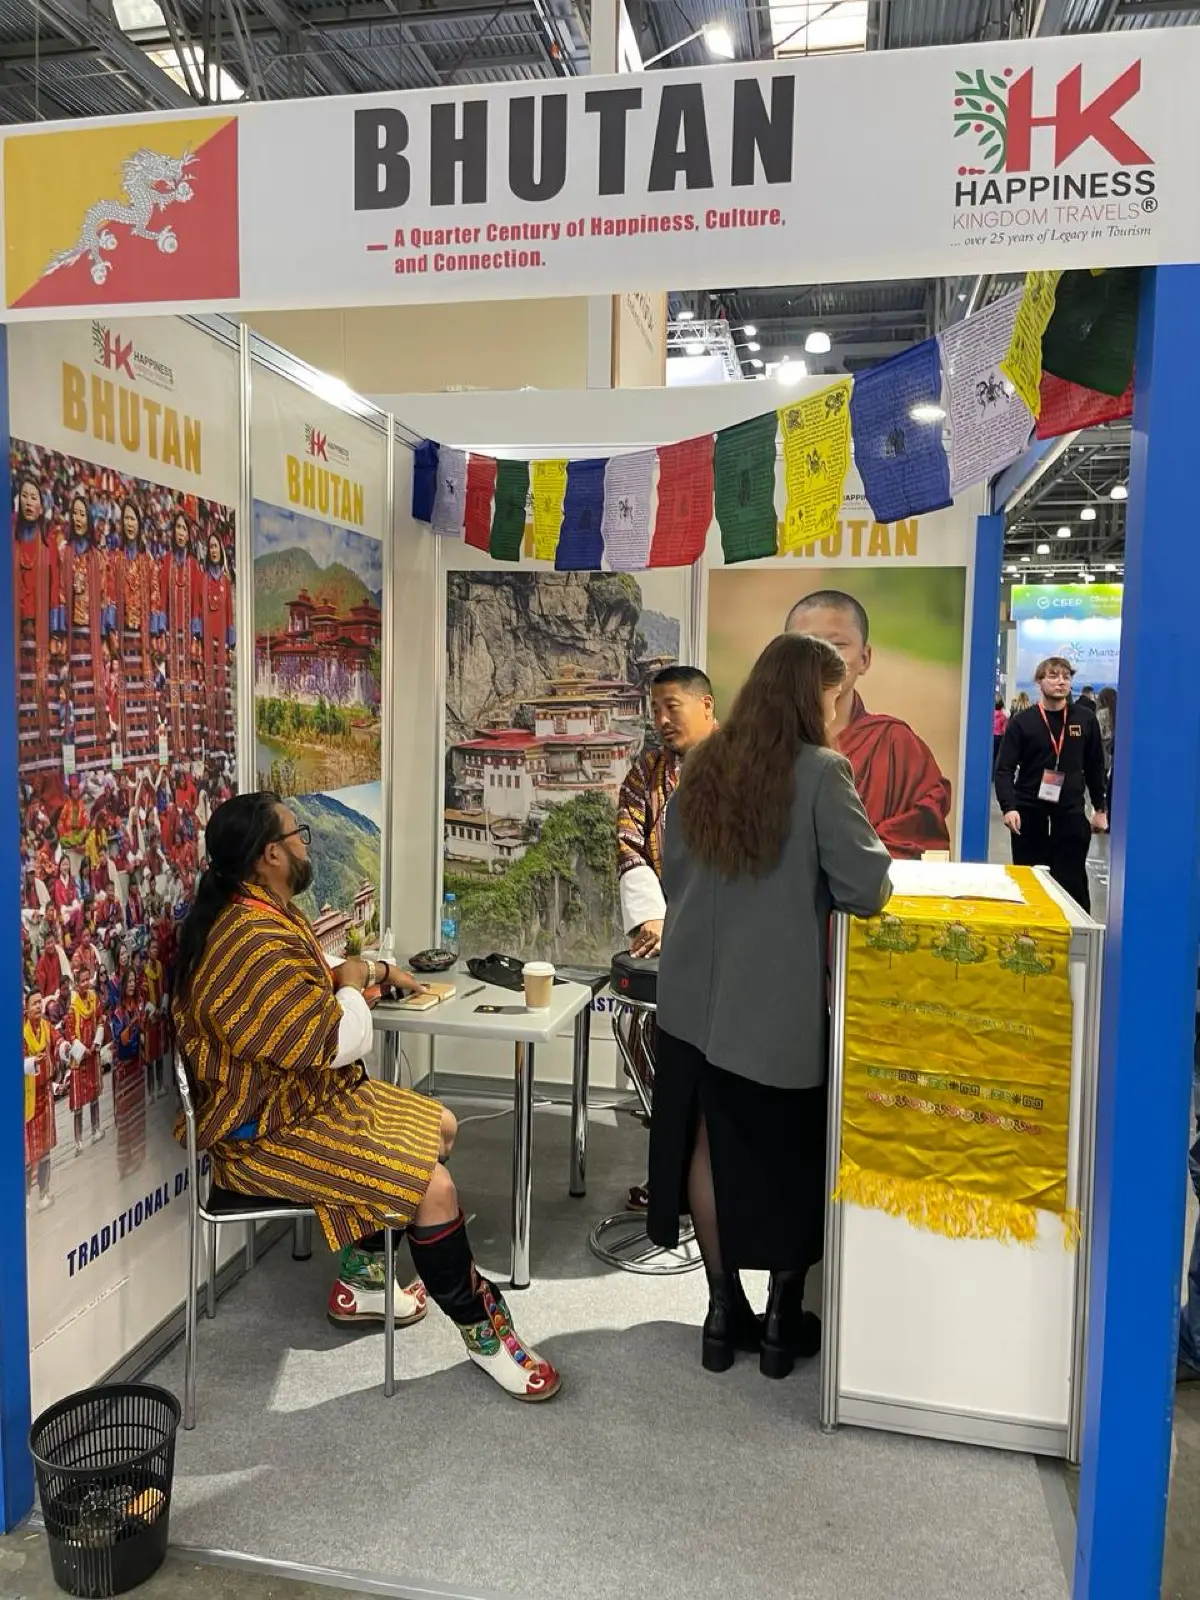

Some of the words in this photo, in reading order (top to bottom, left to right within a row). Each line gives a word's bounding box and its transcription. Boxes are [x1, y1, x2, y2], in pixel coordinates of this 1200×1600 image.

[354, 75, 795, 210] BHUTAN
[1005, 58, 1155, 173] HK
[955, 170, 1155, 207] HAPPINESS
[394, 229, 405, 248] A
[410, 226, 481, 248] Quarter
[486, 221, 561, 242] Century
[566, 218, 585, 238] of
[590, 214, 700, 237] Happiness,
[705, 208, 786, 229] Culture,
[953, 208, 1049, 231] KINGDOM
[964, 235, 987, 247] over
[990, 231, 1005, 246] 25
[1007, 232, 1034, 248] years
[1036, 229, 1051, 247] of
[1050, 228, 1088, 244] Legacy
[1090, 226, 1102, 239] in
[1107, 224, 1152, 238] Tourism
[394, 254, 428, 275] and
[433, 249, 547, 273] Connection.
[62, 360, 202, 475] BHUTAN
[286, 453, 364, 526] BHUTAN
[67, 1182, 170, 1277] TRADITIONAL
